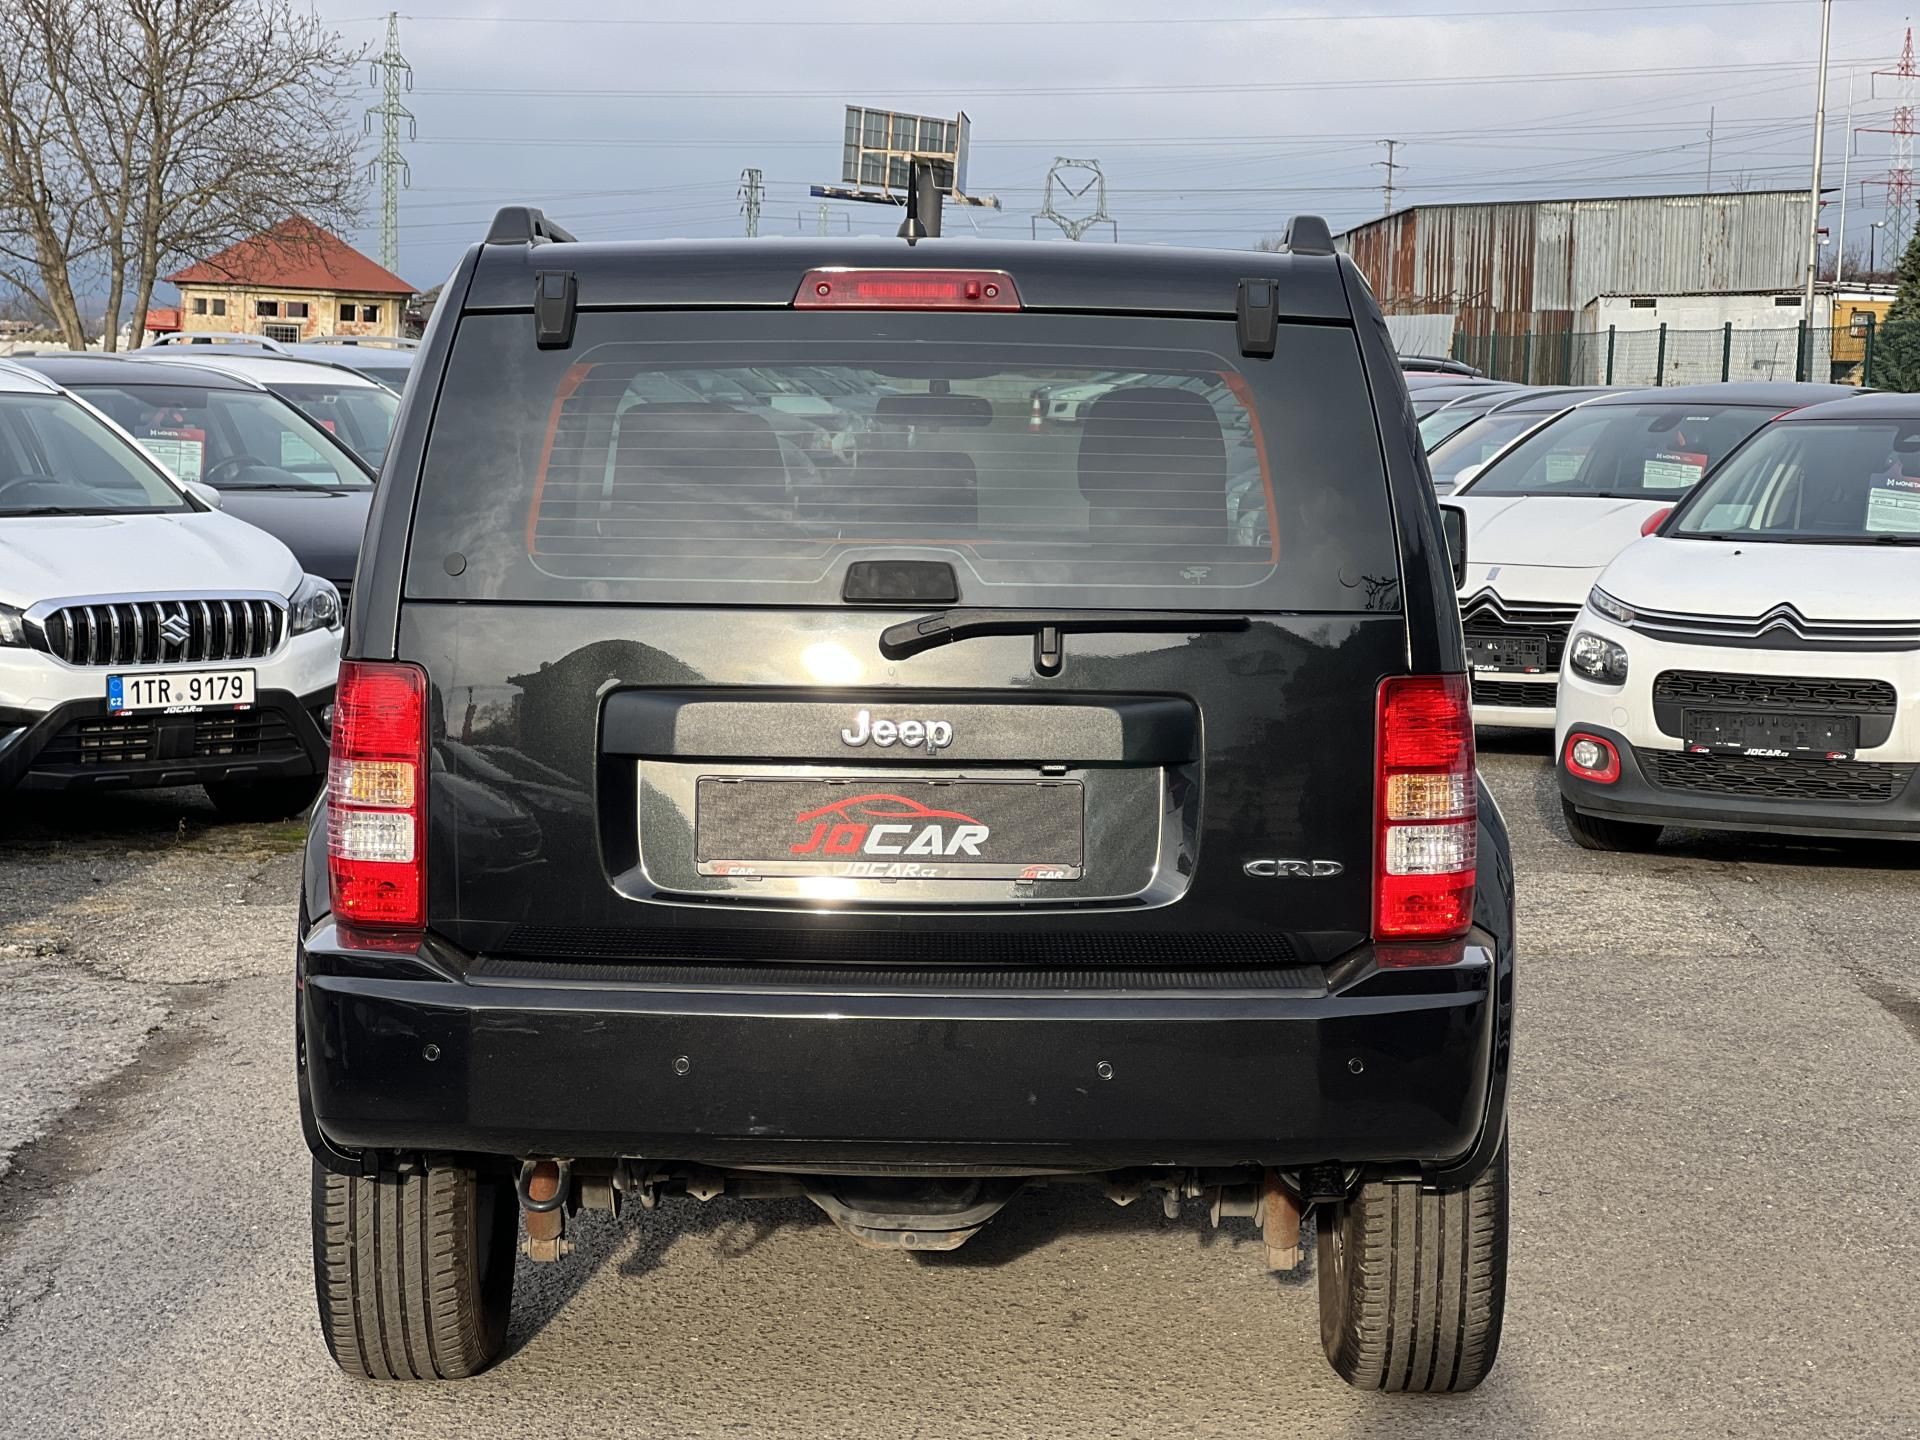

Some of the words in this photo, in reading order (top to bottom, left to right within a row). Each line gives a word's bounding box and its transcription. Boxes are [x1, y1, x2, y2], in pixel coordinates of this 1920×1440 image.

[110, 697, 122, 707] CZ
[131, 679, 171, 704] 1TR
[189, 676, 243, 701] 9179
[841, 710, 953, 755] Jeep
[790, 824, 990, 856] JOCAR
[1243, 859, 1344, 878] CRD
